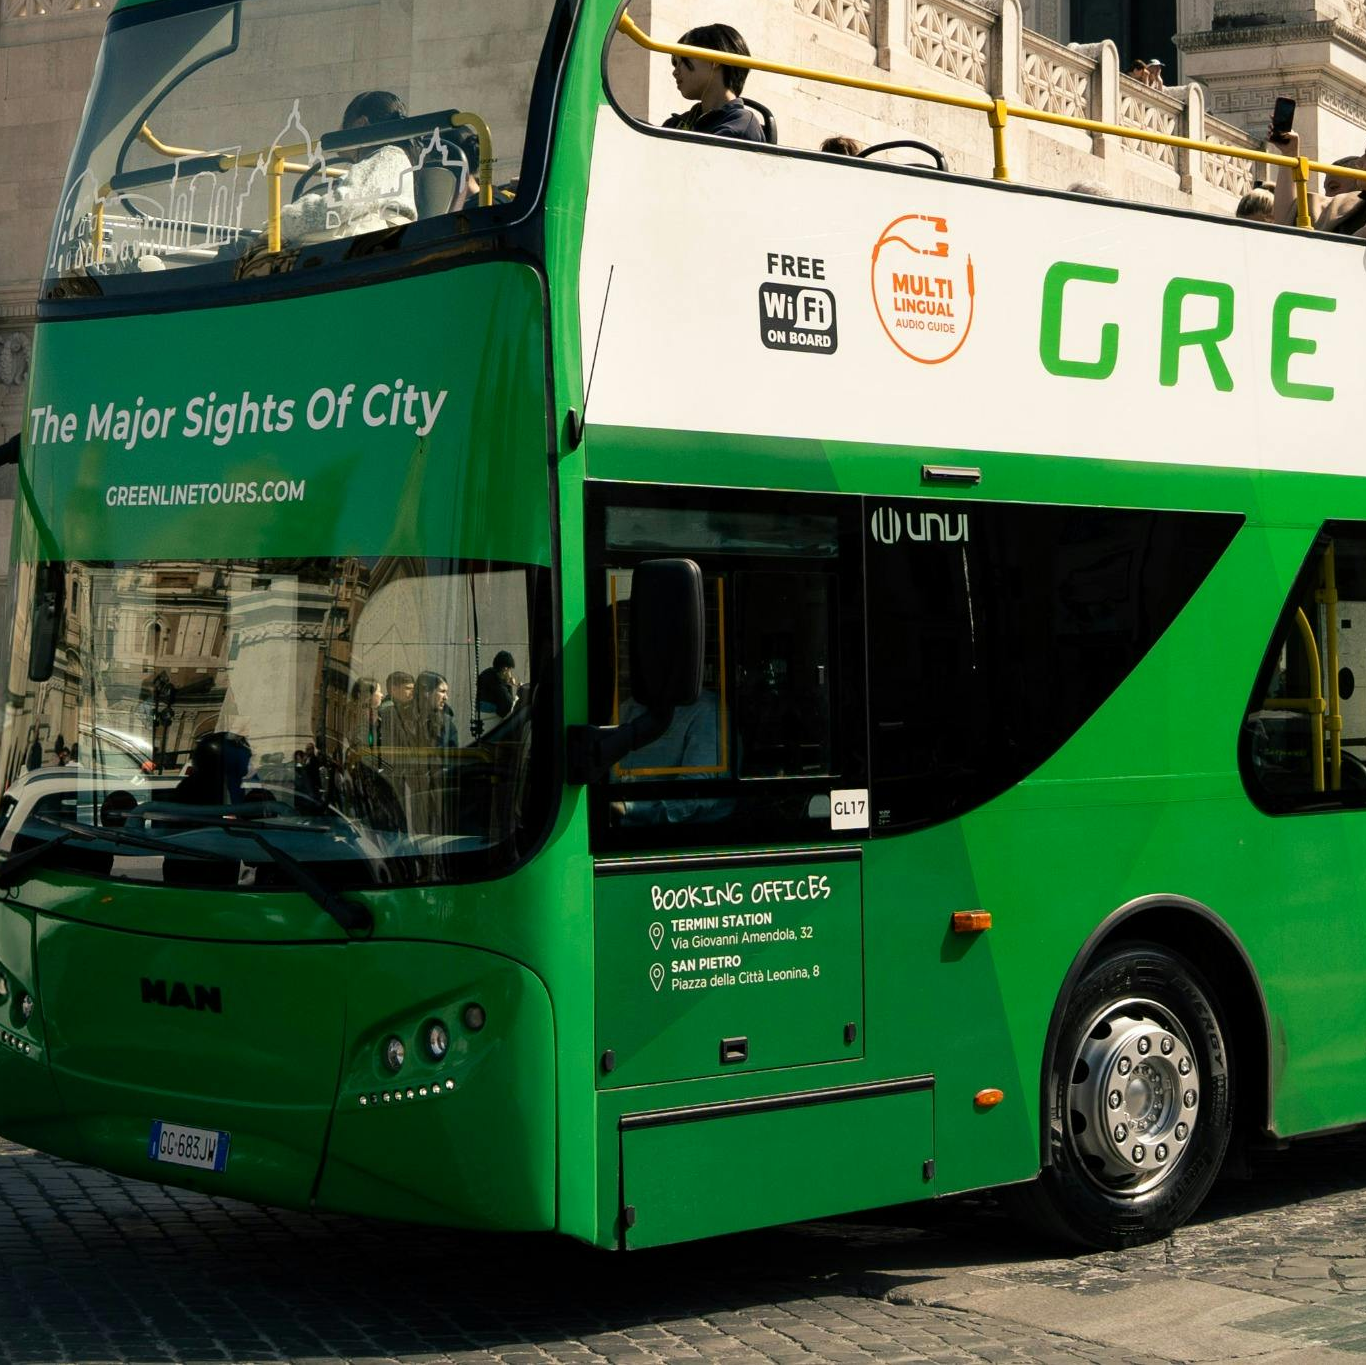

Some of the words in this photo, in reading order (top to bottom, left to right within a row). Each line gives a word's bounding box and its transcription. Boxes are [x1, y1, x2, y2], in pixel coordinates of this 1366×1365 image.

[767, 252, 826, 280] FREE
[892, 273, 953, 300] MULTI
[894, 297, 955, 318] LINGUAL
[767, 329, 786, 343] ON
[789, 331, 831, 348] BOARD
[895, 318, 925, 331] AUDIO
[927, 321, 956, 334] GUIDE
[30, 406, 76, 446] The
[85, 396, 176, 450] Major
[182, 391, 294, 446] Sights
[306, 382, 355, 431] Of
[361, 378, 448, 436] City
[105, 479, 306, 507] GREENLINETOURS.COM
[834, 800, 866, 815] GL17
[651, 881, 743, 912] BOOKING
[751, 875, 832, 904] OFFICES
[671, 916, 719, 933] TERMINI
[722, 912, 772, 928] STATION
[671, 936, 689, 950] Via
[691, 931, 739, 949] Giovanni
[741, 927, 798, 946] Amendola,
[800, 926, 814, 940] 32
[671, 959, 696, 973] SAN
[699, 955, 741, 971] PIETRO
[671, 976, 707, 991] Piazza
[709, 971, 736, 987] della
[738, 968, 764, 985] Città
[767, 966, 810, 983] Leonina,
[813, 965, 820, 977] 8
[140, 977, 223, 1013] MAN
